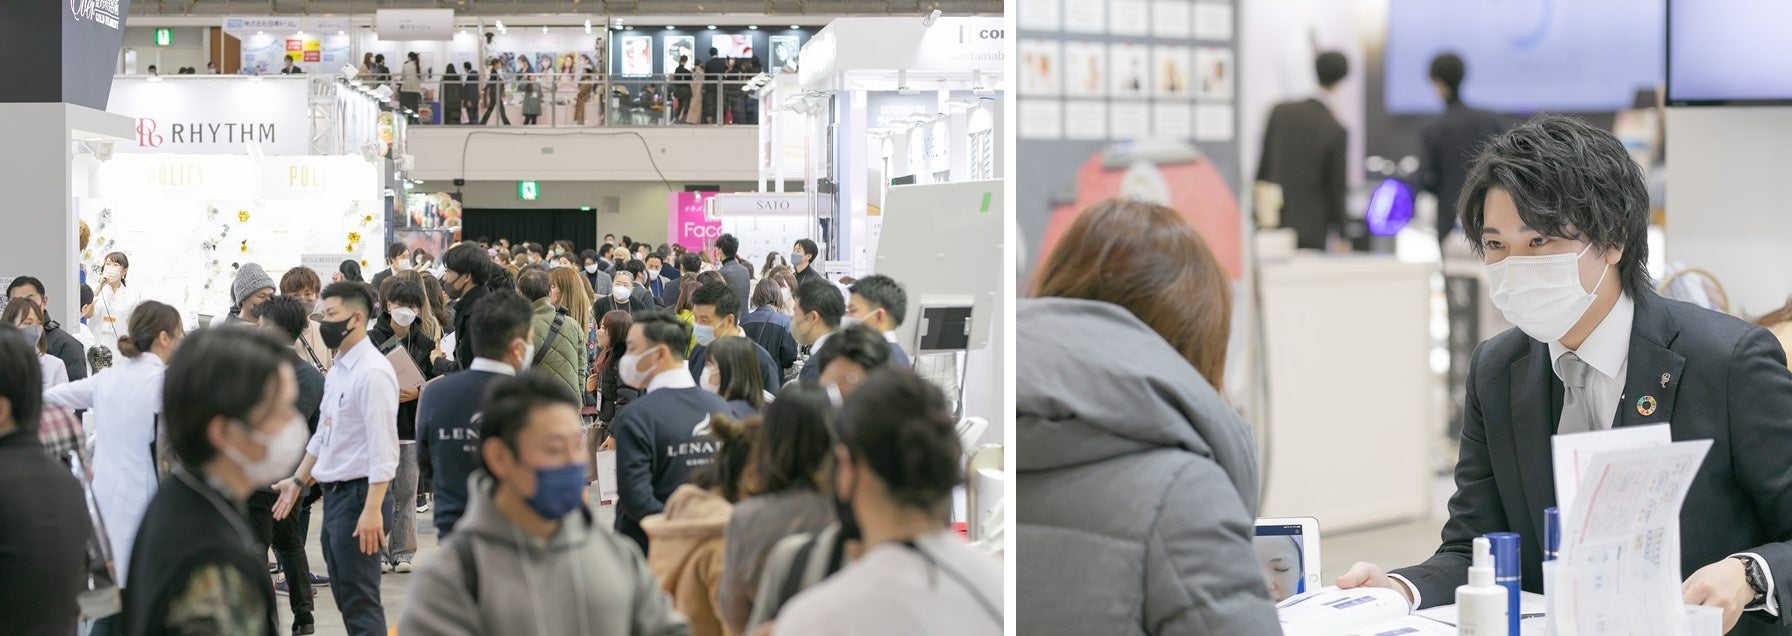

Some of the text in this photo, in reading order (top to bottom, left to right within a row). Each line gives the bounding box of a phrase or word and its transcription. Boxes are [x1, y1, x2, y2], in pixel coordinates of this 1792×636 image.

[979, 29, 1004, 39] co
[172, 123, 275, 143] RHYTHM
[146, 164, 205, 187] POLICY
[289, 164, 335, 187] POLI
[756, 200, 790, 210] SATO
